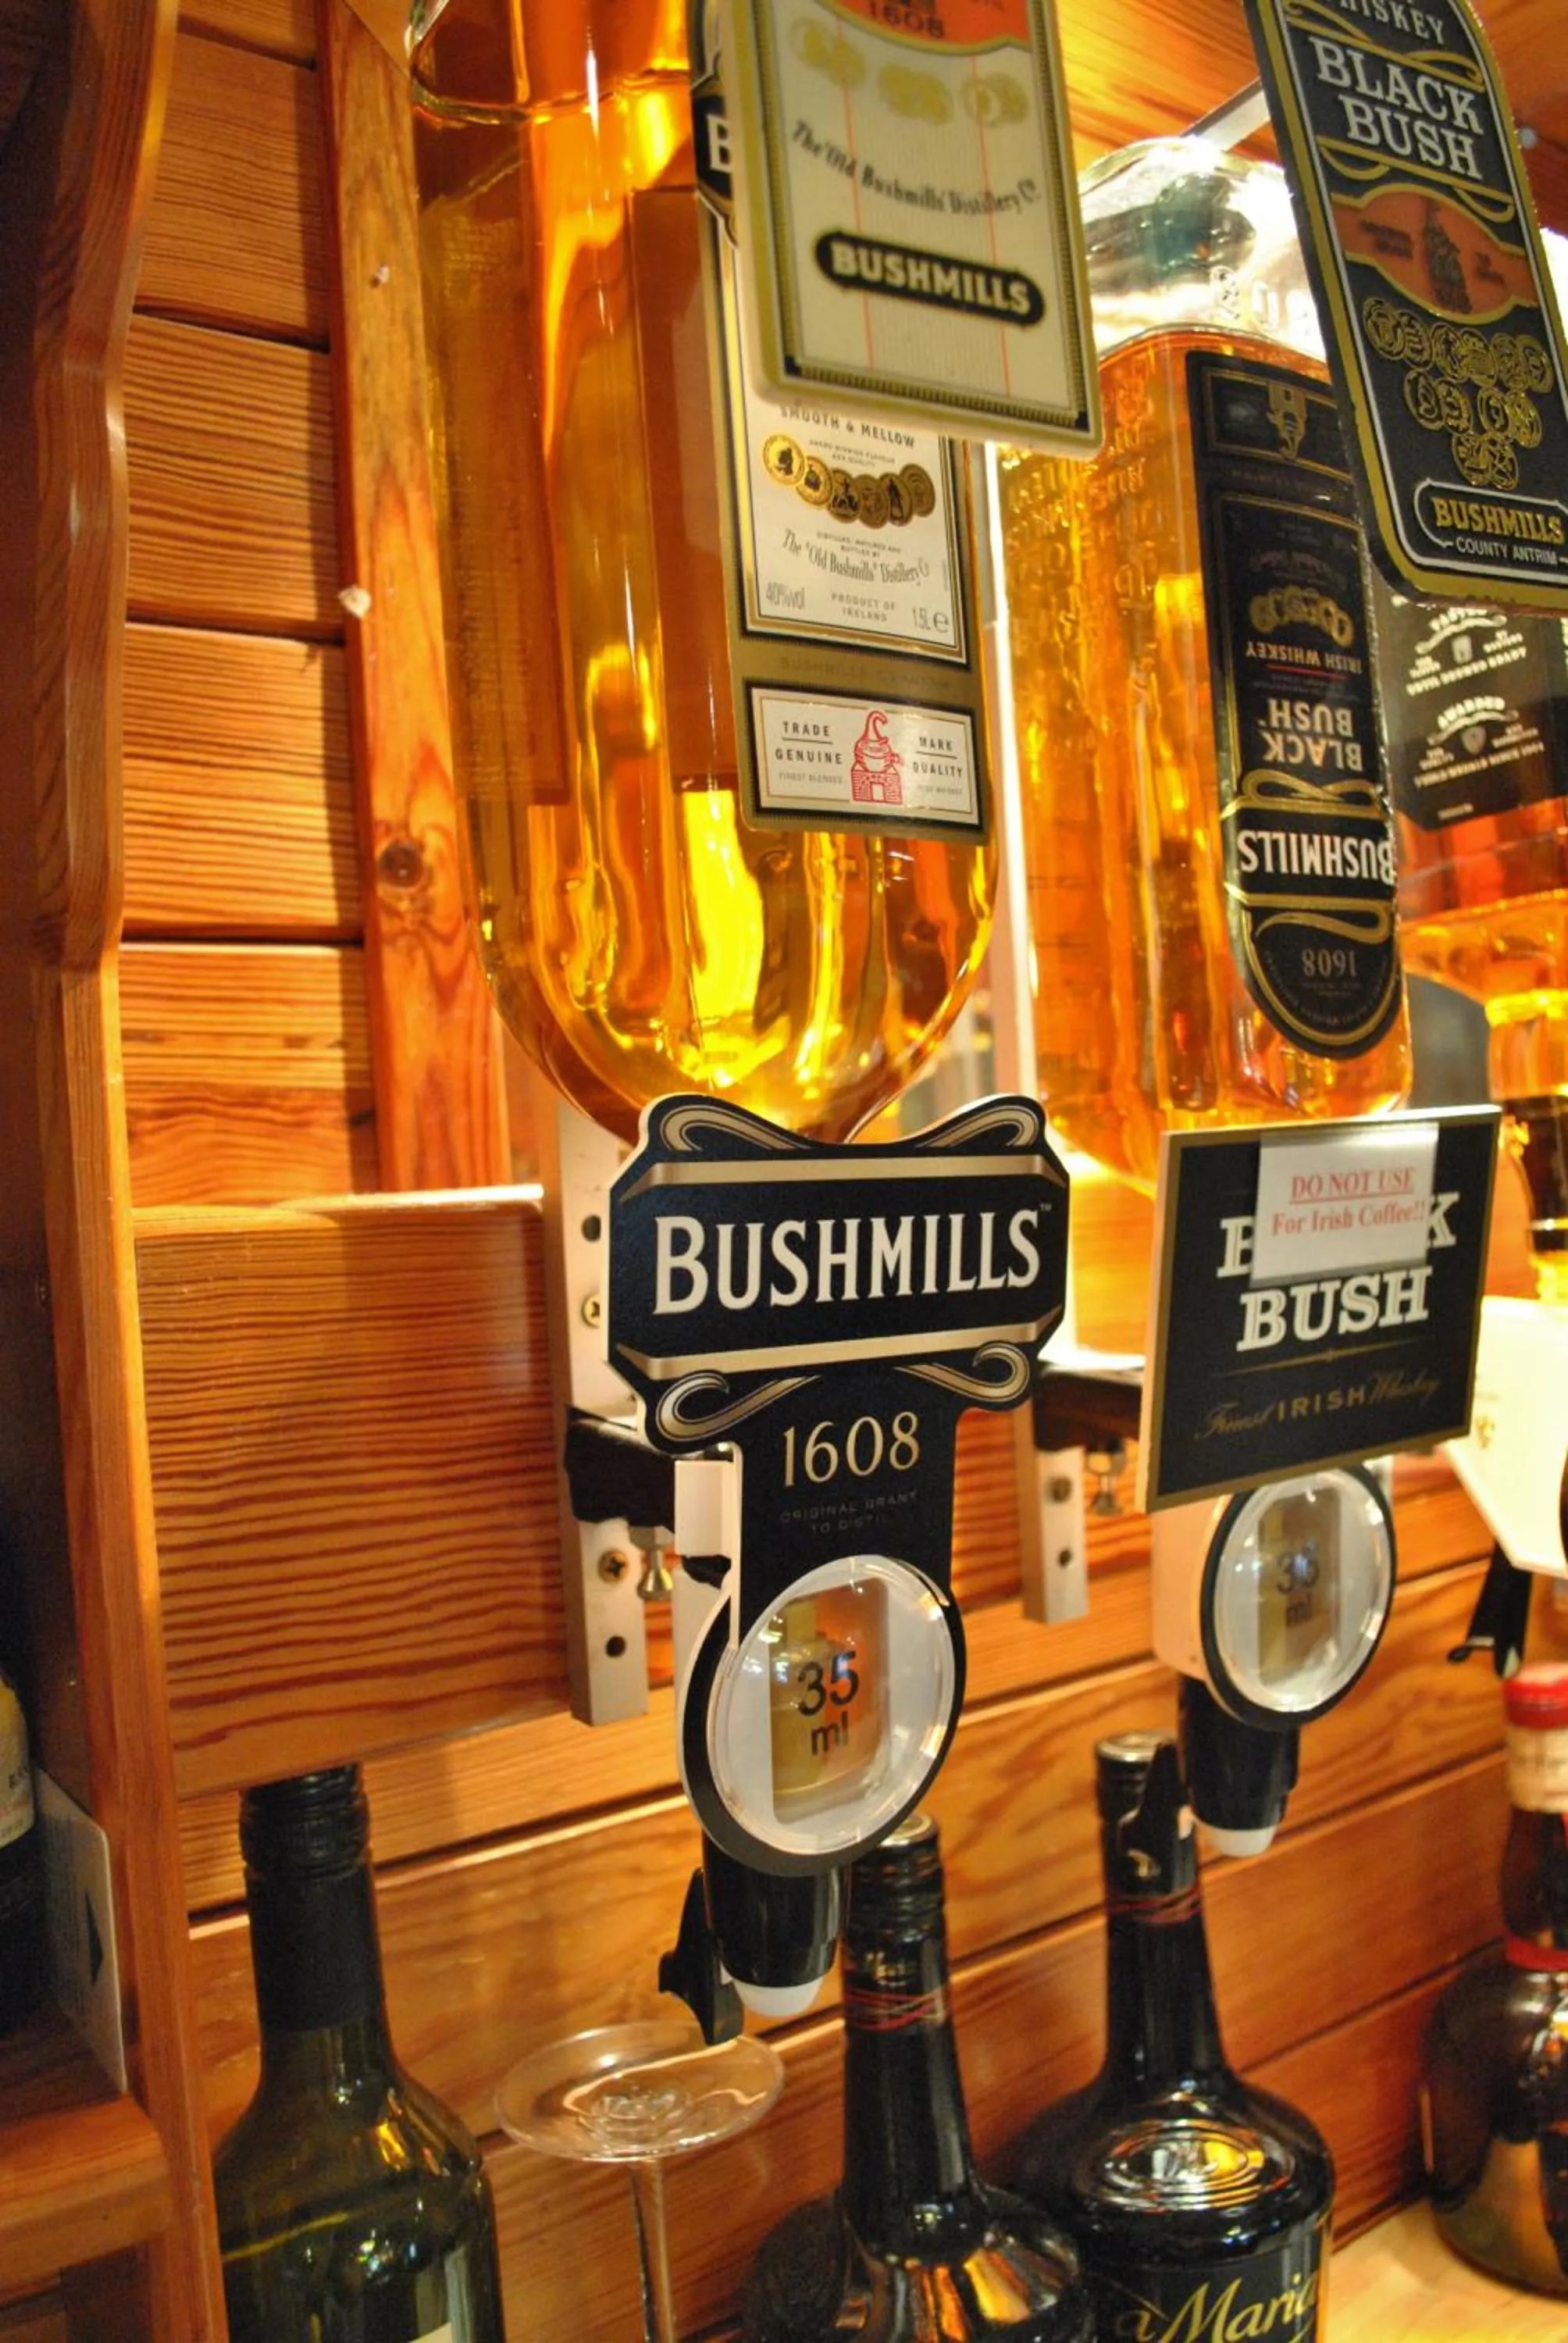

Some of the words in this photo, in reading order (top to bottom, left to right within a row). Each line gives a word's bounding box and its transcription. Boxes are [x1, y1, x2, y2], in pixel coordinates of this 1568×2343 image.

[1309, 36, 1484, 135] BLACK
[1338, 94, 1483, 180] BUSH
[830, 241, 1031, 314] BUSHMILLS
[781, 405, 840, 430] SMOOTH
[861, 423, 916, 450] MELLOW
[1431, 496, 1565, 546] BUSHMILLS
[1456, 536, 1508, 559] COUNTY
[1513, 544, 1559, 568] ANTRIM
[832, 592, 880, 610] PRODUCT
[843, 606, 888, 622] IRELAND
[1245, 640, 1321, 666] WHISKEY
[1324, 651, 1363, 676] IRISH
[782, 721, 830, 737] TRADE
[1268, 700, 1352, 733] BUSH
[775, 747, 843, 765] GENUINE
[918, 736, 953, 751] MARK
[1263, 730, 1362, 772] BLACK
[912, 761, 964, 779] QUALITY
[1237, 829, 1397, 886] BUSHMILLS
[1301, 948, 1357, 979] 1608
[1292, 1174, 1324, 1199] DO
[1329, 1171, 1371, 1195] NOT
[1377, 1167, 1416, 1192] USE
[1270, 1211, 1307, 1236] For
[1311, 1207, 1353, 1232] Irish
[651, 1207, 1041, 1316] BUSHMILLS
[1237, 1265, 1433, 1352] BUSH
[1278, 1383, 1367, 1423] IRISH
[782, 1410, 921, 1488] 1608
[797, 1650, 860, 1717] 35
[811, 1711, 850, 1756] ml
